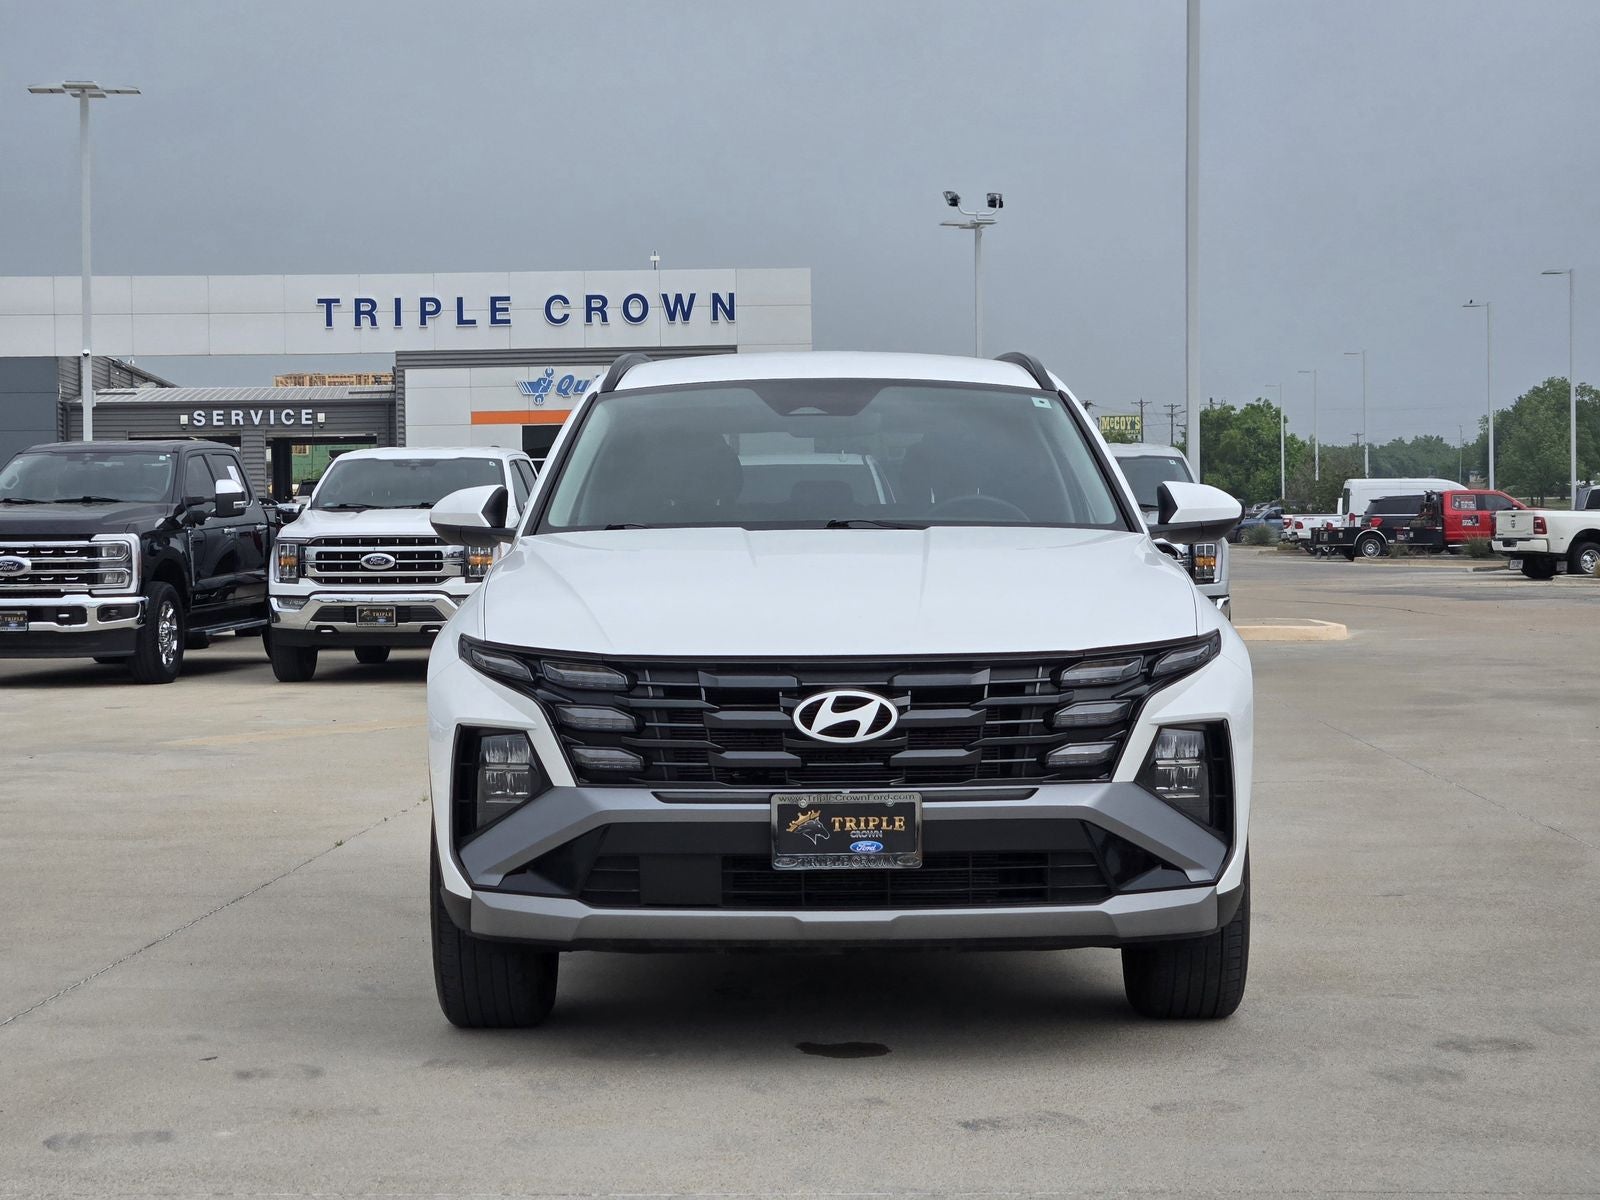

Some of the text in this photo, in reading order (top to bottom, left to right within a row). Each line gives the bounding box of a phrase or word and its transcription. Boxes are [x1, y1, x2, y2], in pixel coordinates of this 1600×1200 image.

[317, 292, 737, 329] TRIPLE CROWN
[193, 409, 313, 427] SERVICE
[831, 816, 905, 832] TRIPLE
[850, 830, 883, 838] CROWN
[856, 842, 877, 852] Ford
